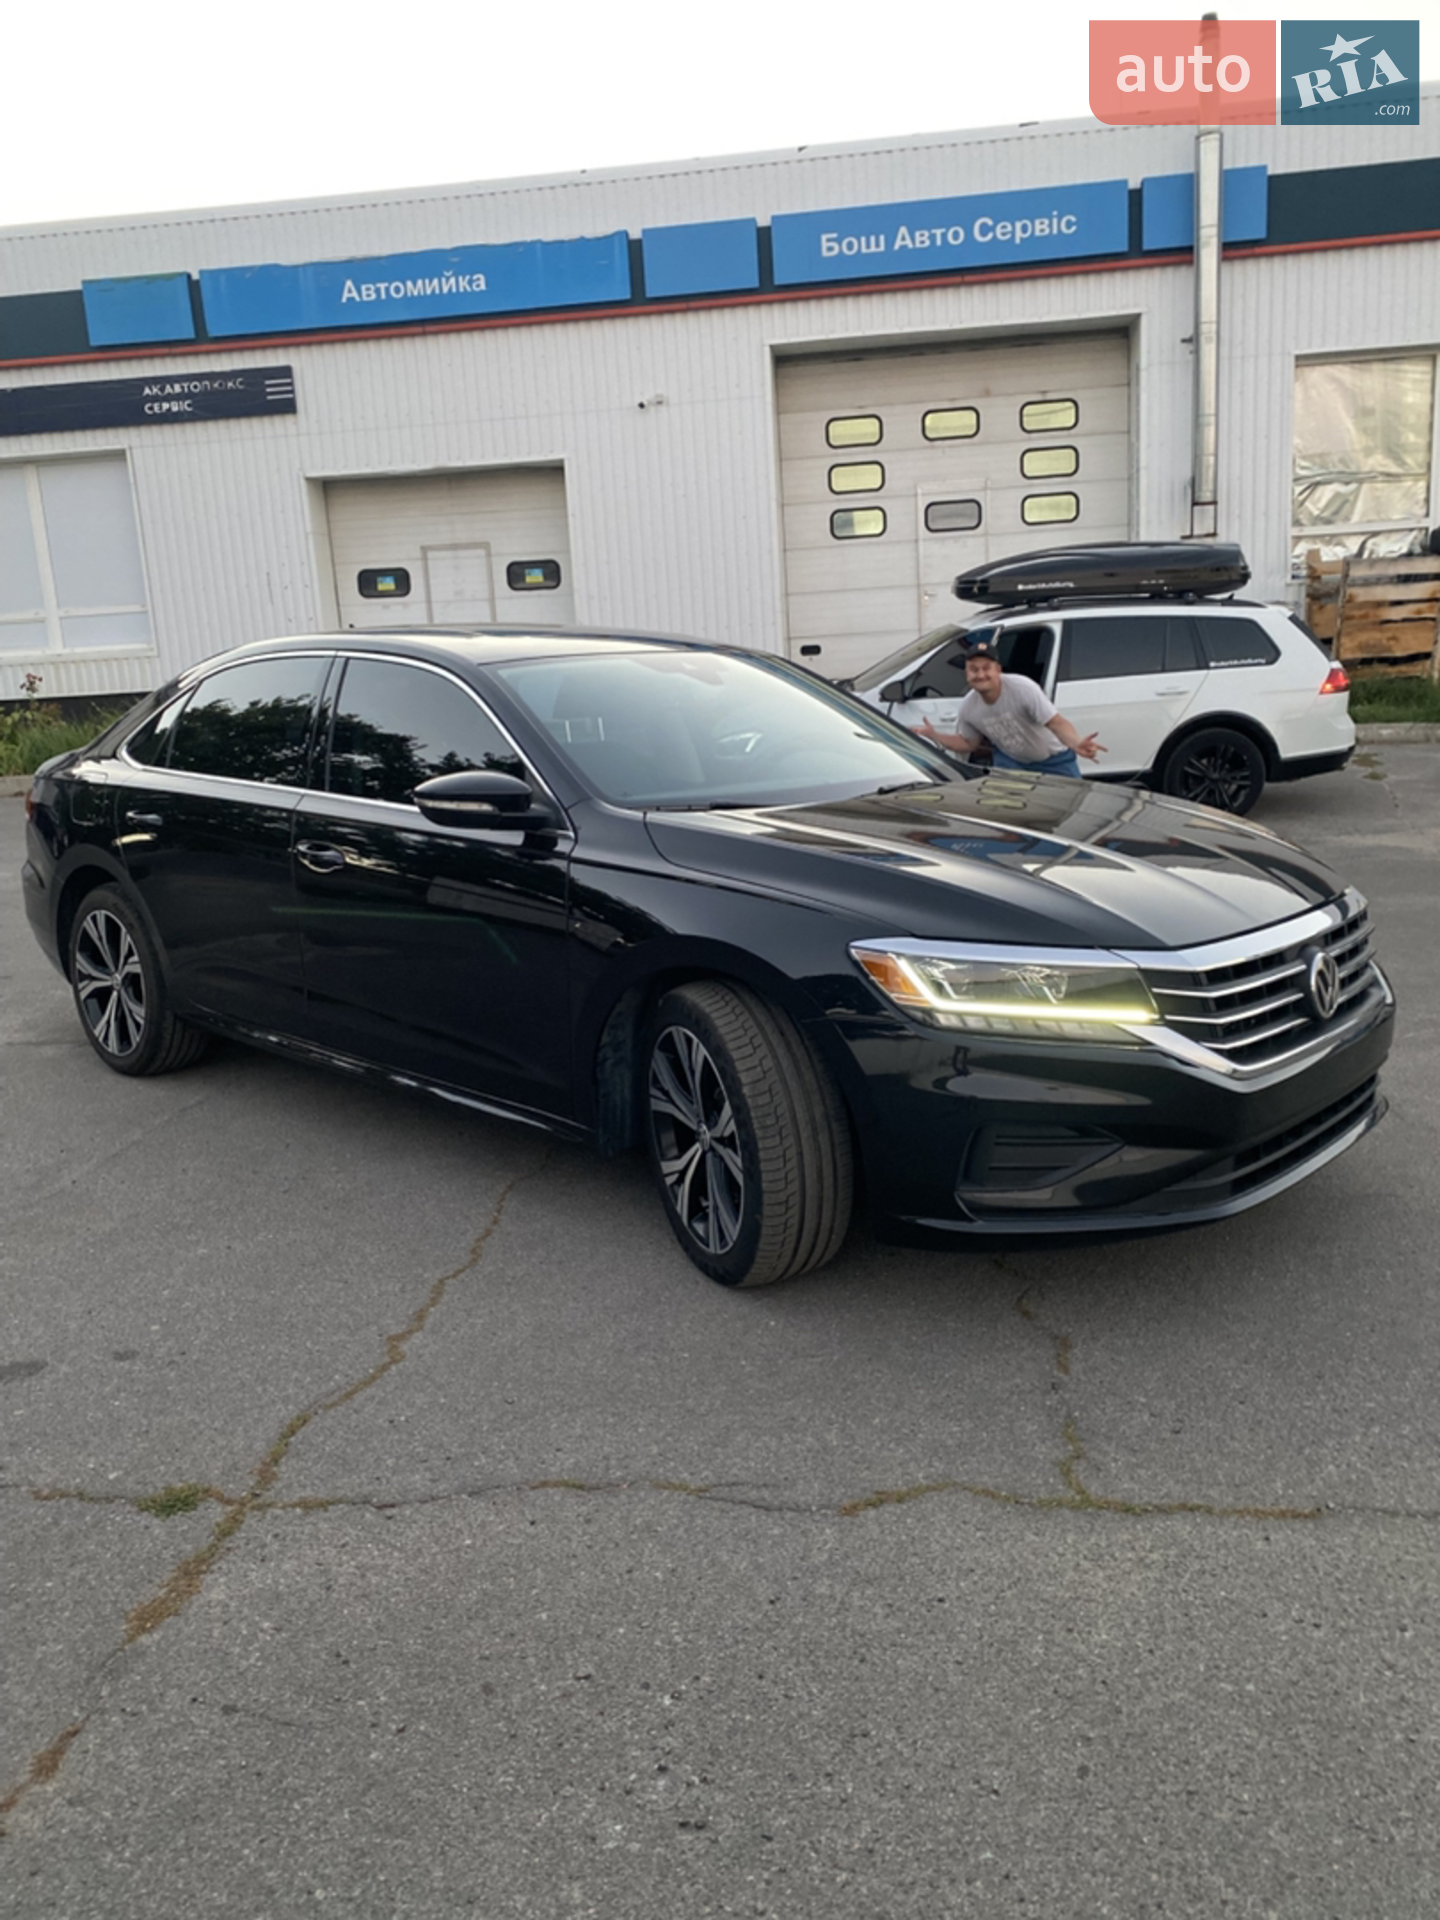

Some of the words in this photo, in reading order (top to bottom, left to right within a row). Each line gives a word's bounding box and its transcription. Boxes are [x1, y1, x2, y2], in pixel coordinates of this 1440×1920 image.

[820, 232, 886, 258] Бош
[893, 225, 966, 251] Авто
[972, 210, 1078, 245] Сервіс
[341, 269, 488, 304] Автомийка
[144, 400, 194, 415] СЕРВІС
